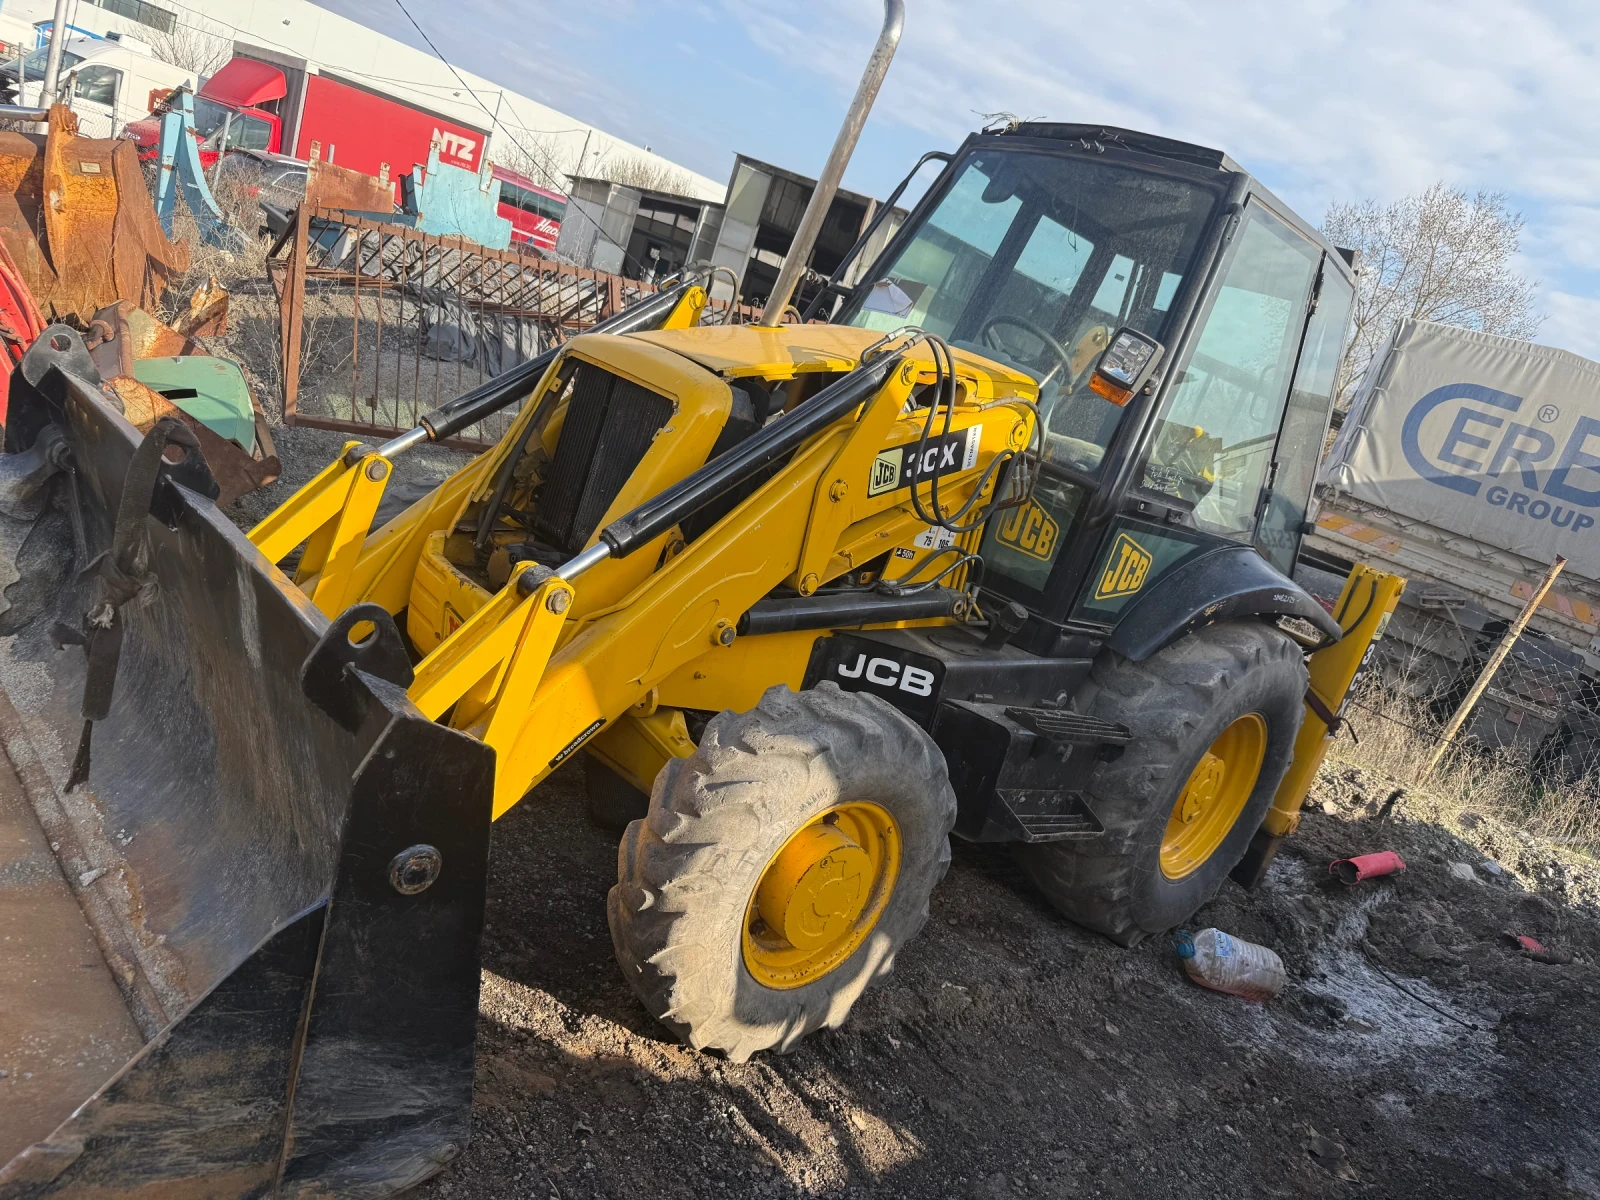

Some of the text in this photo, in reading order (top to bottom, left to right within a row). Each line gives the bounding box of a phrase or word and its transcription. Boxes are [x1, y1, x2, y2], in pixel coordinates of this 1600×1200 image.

[431, 127, 476, 162] NTZ
[875, 442, 958, 487] JCB 3CX
[1001, 501, 1055, 556] JCB
[1485, 485, 1595, 533] GROUP
[923, 535, 933, 547] 75
[1101, 542, 1149, 593] JCB
[838, 653, 935, 697] JCB
